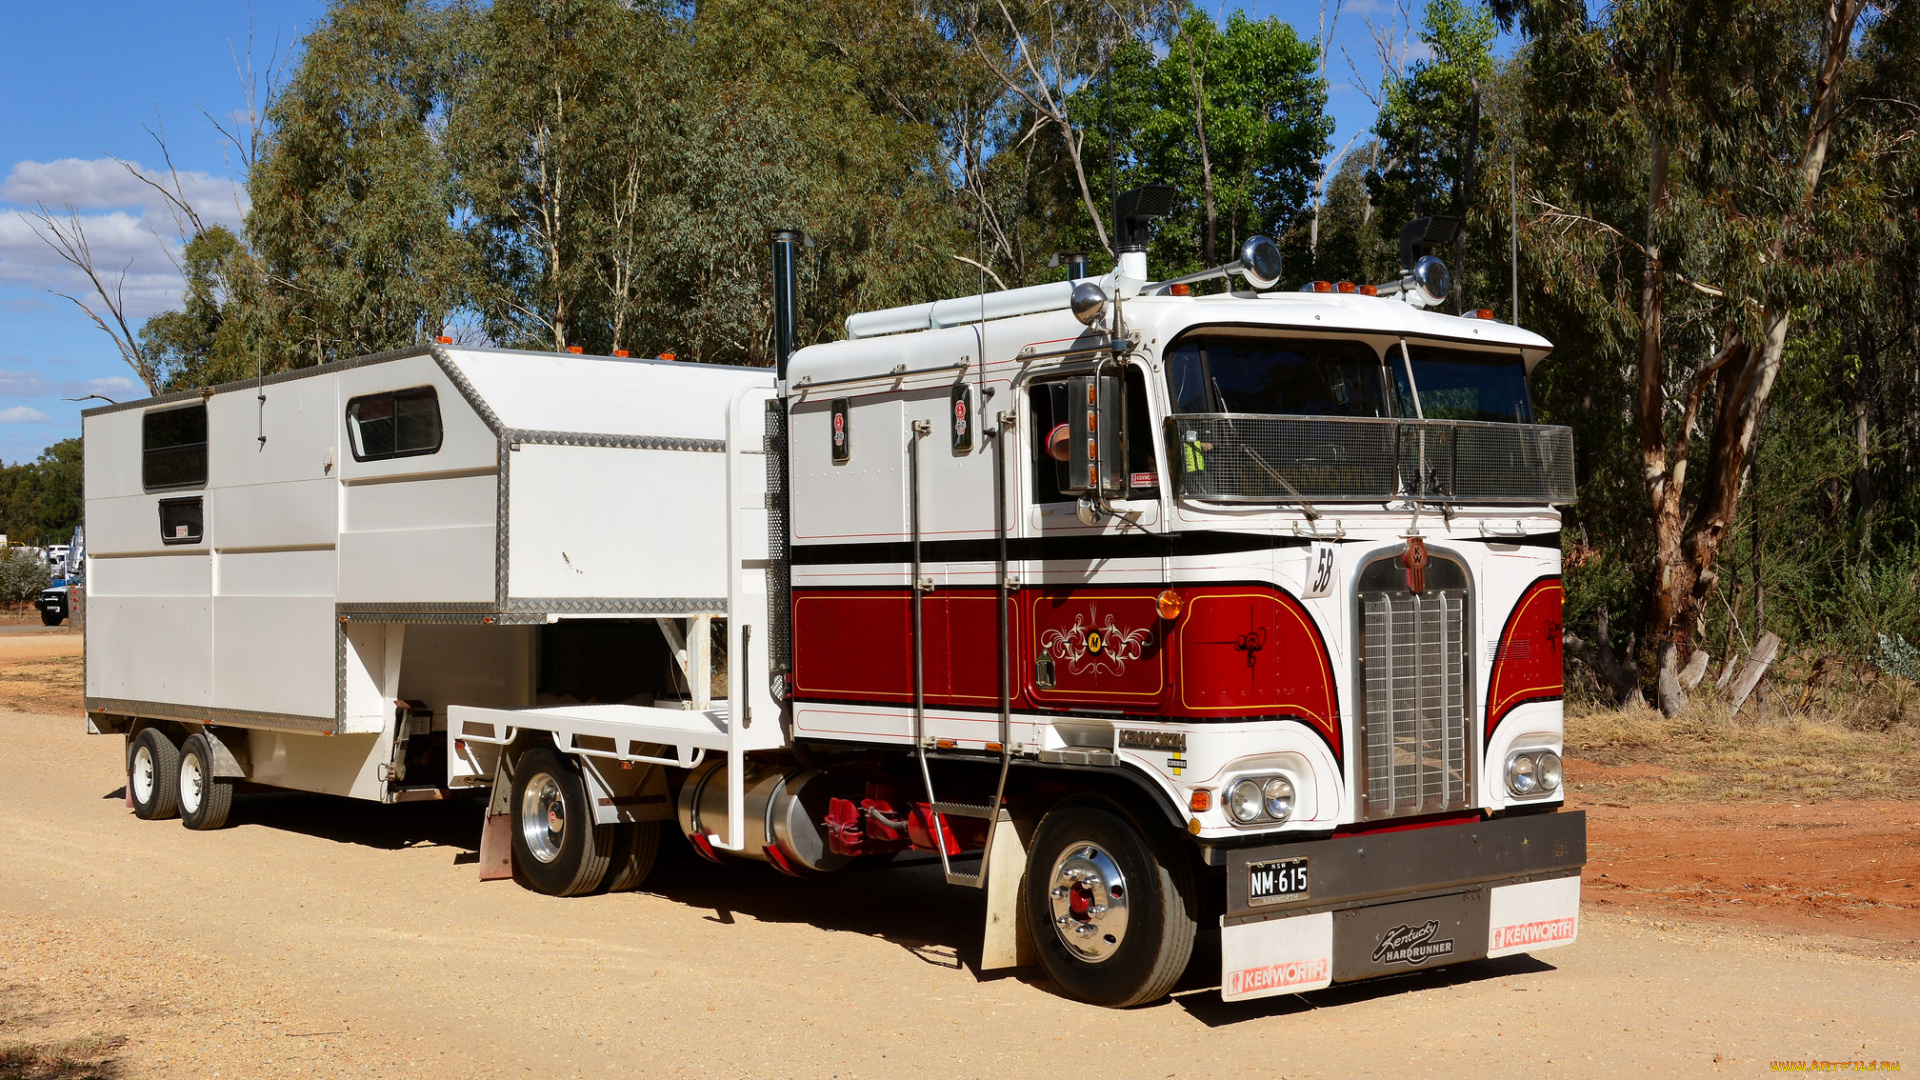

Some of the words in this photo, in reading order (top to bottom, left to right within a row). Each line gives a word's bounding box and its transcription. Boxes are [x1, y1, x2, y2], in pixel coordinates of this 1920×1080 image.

[1313, 548, 1334, 593] 58
[1119, 730, 1186, 748] KENWORTH
[1271, 862, 1287, 870] NSW
[1373, 922, 1437, 962] Kentucky
[1506, 921, 1573, 944] KENWORTH
[1386, 942, 1452, 961] HARDRUNNER
[1245, 961, 1325, 989] KENWORTH
